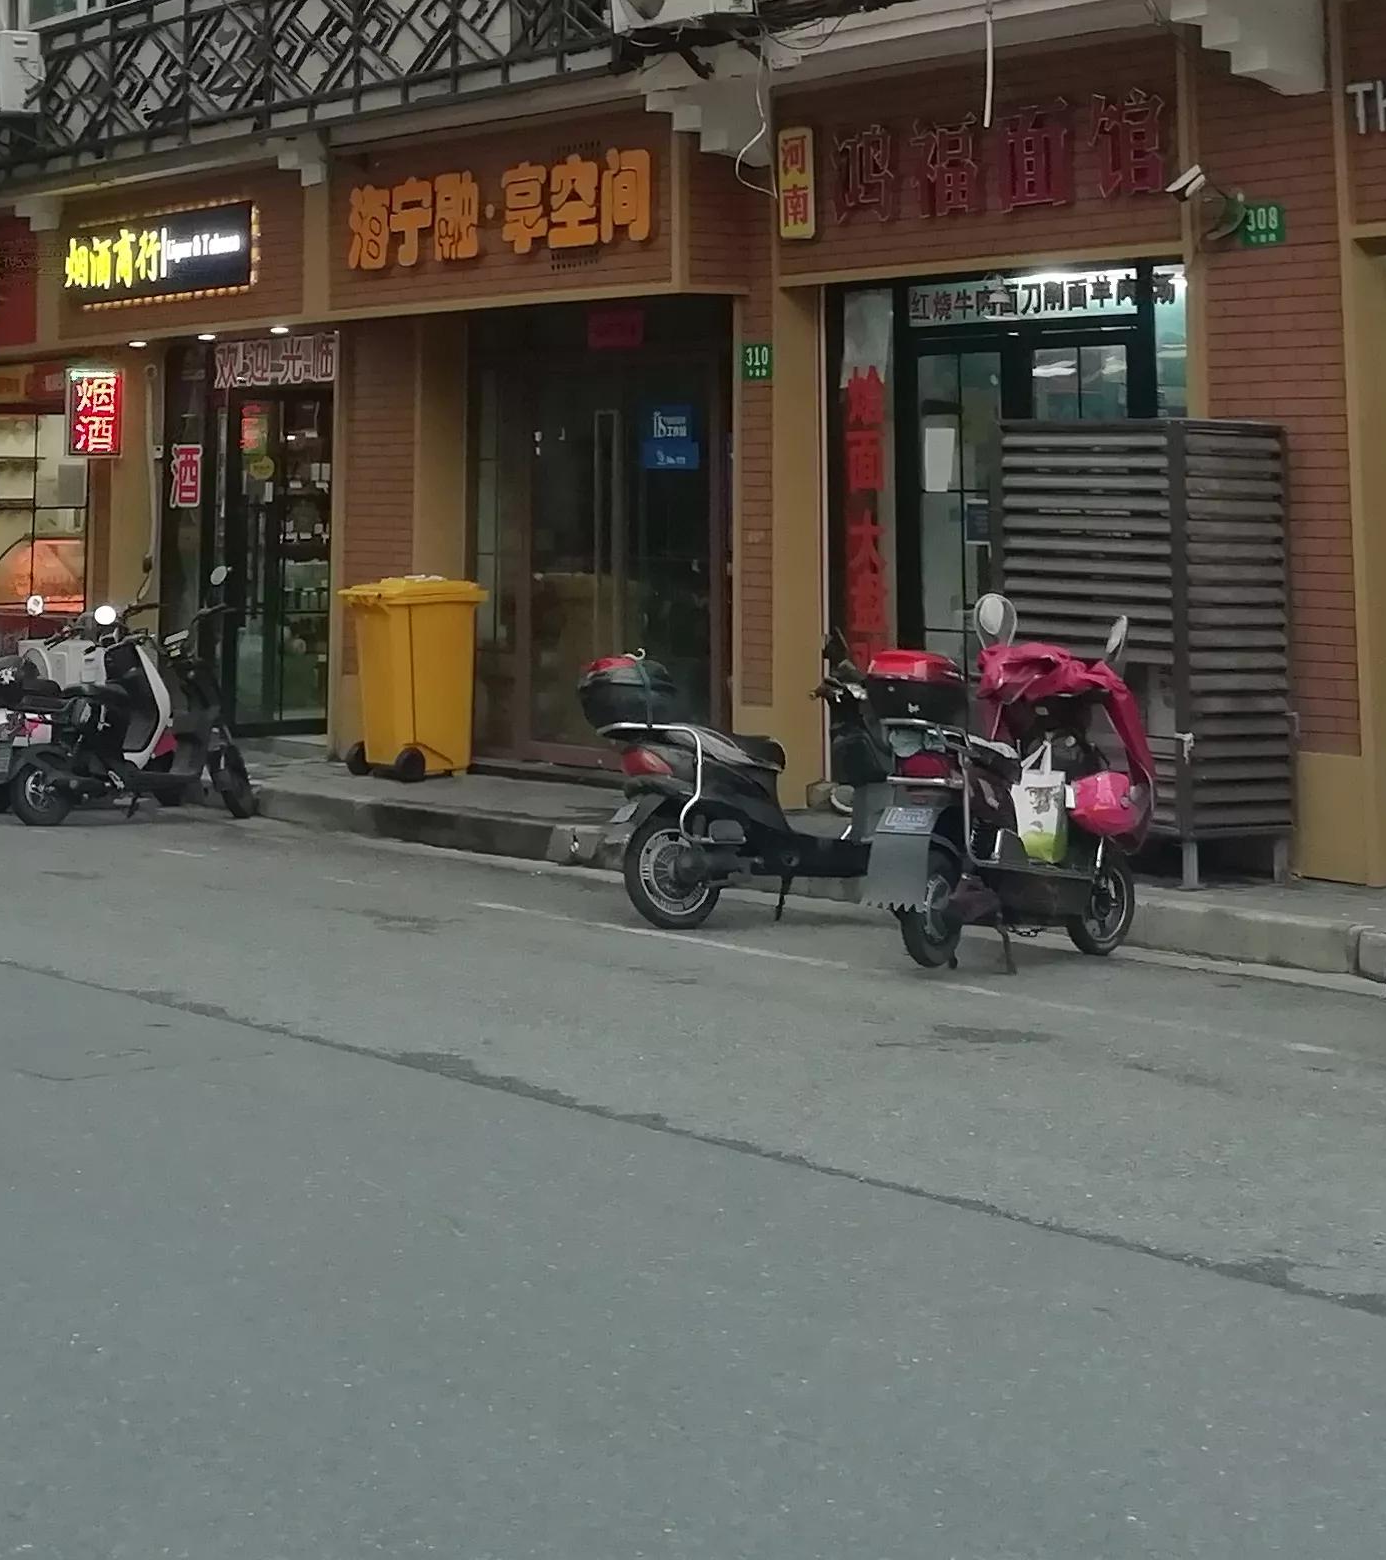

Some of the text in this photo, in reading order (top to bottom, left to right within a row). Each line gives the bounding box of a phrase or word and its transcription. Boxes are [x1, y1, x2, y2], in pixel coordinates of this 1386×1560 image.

[781, 135, 809, 227] 河南
[832, 88, 1164, 224] 鸿福面馆
[1246, 206, 1278, 232] 308
[64, 229, 160, 289] 烟酒商行
[215, 333, 335, 389] 欢迎光临
[745, 346, 769, 366] 310
[76, 376, 117, 452] 烟酒
